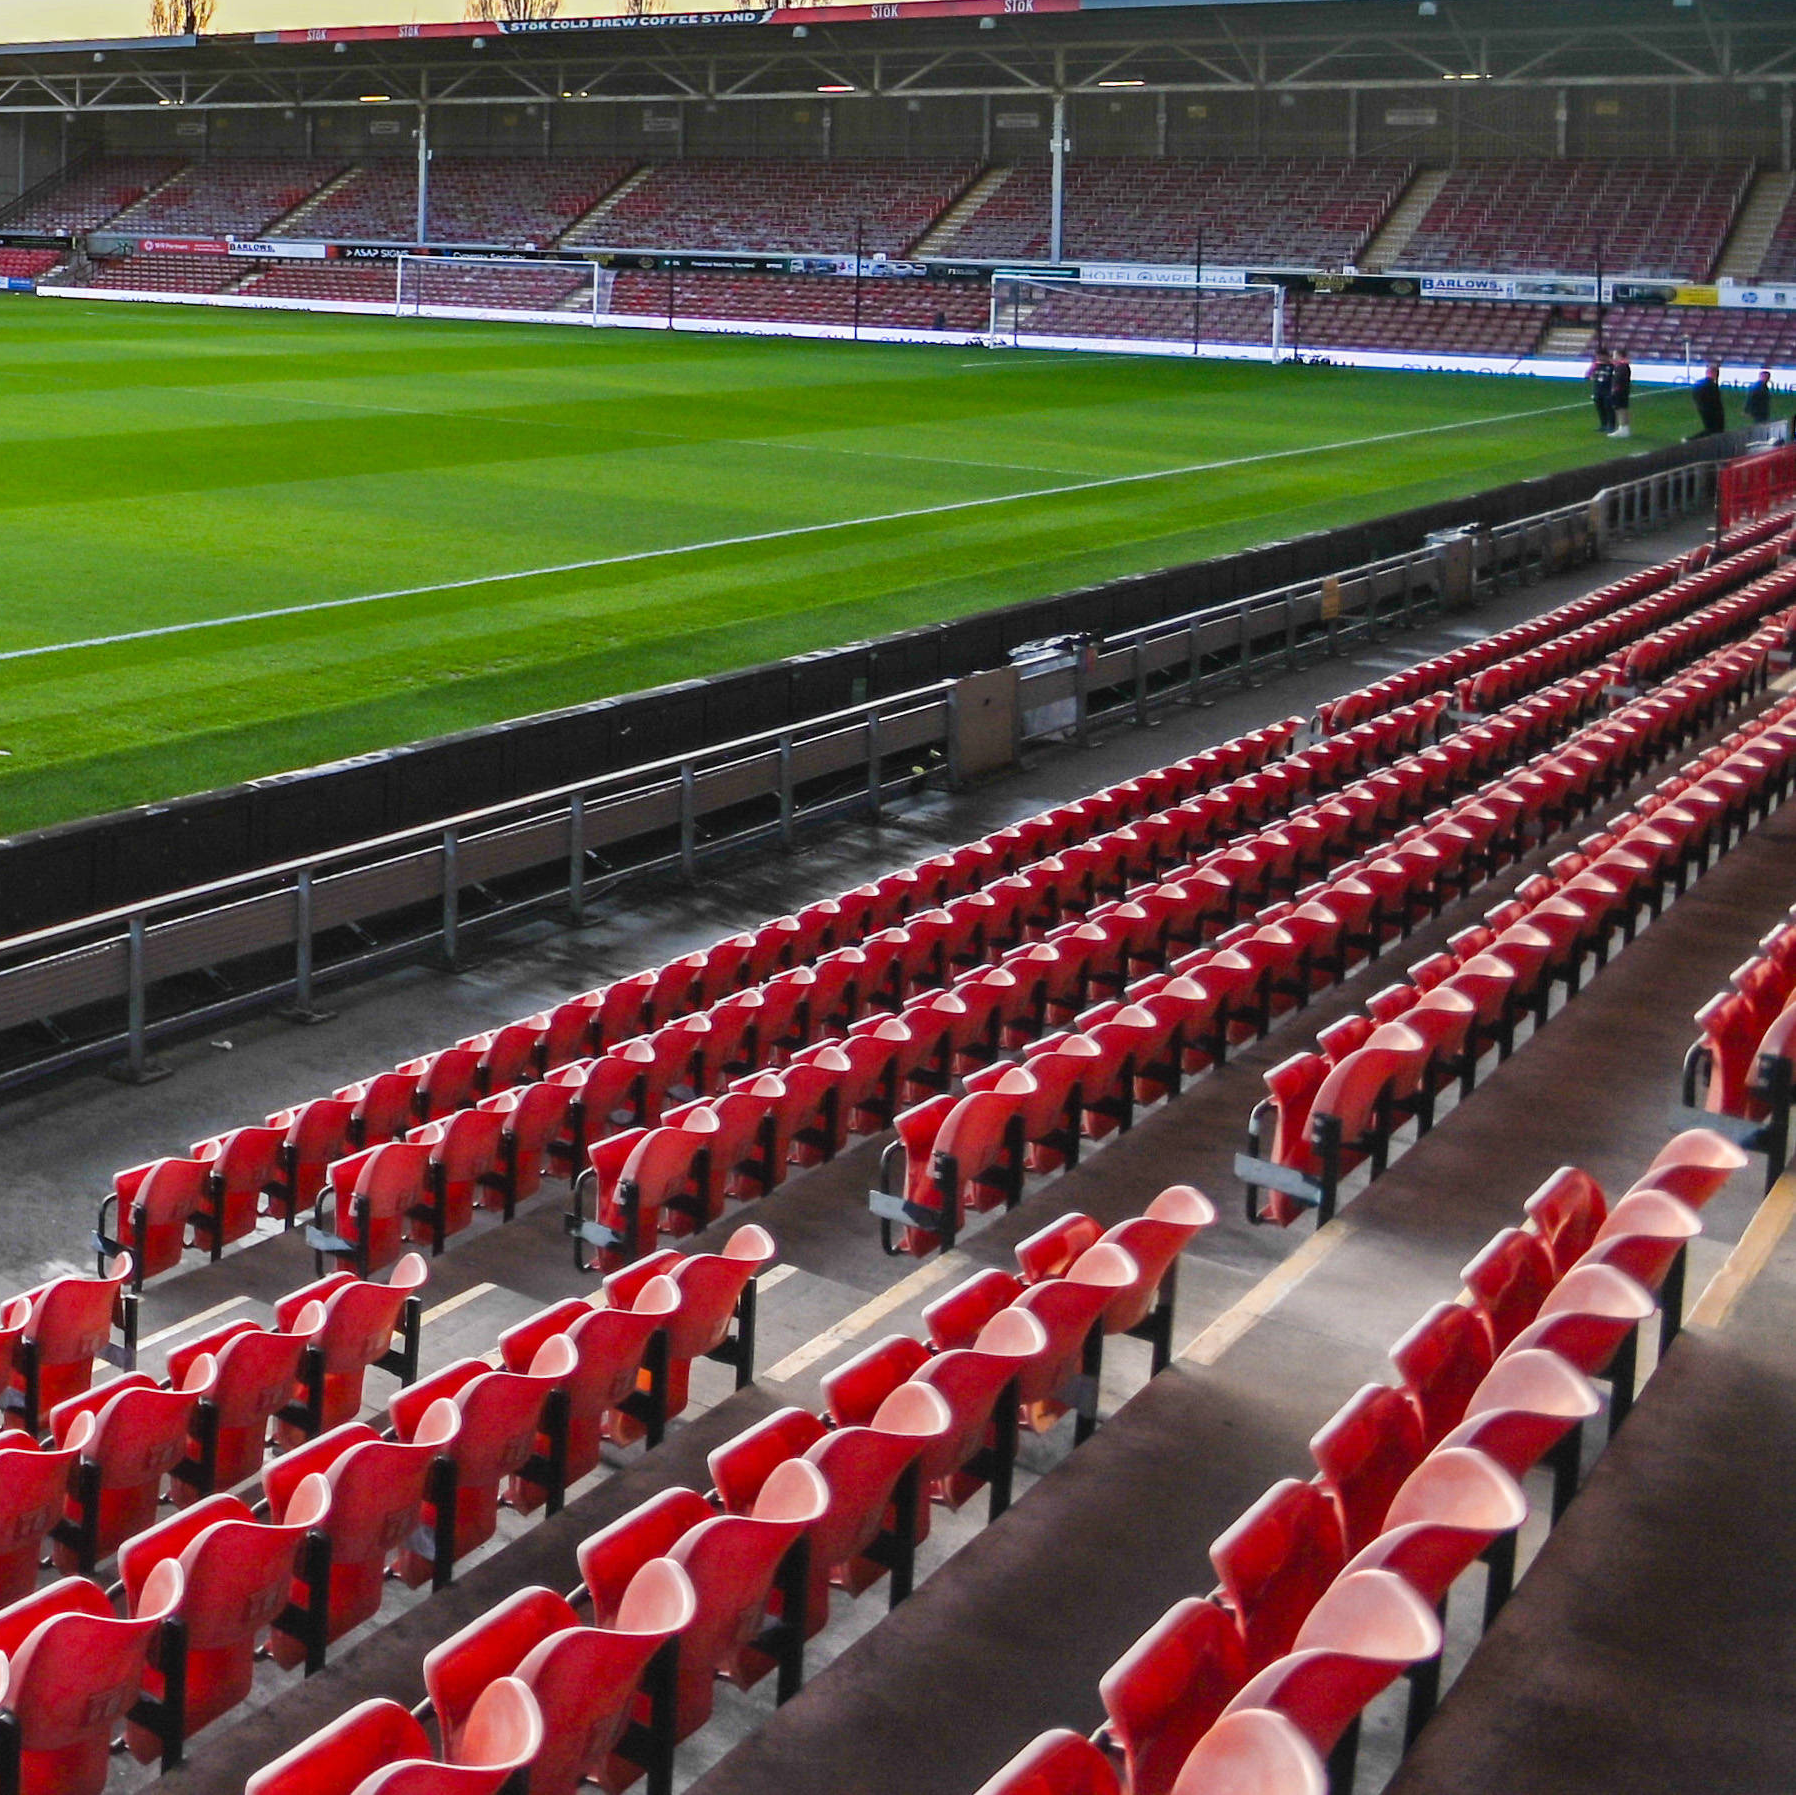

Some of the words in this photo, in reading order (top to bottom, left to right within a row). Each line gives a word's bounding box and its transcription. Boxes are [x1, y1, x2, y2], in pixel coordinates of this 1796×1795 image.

[551, 19, 589, 30] COLD
[592, 17, 638, 28] BREW
[639, 14, 699, 26] COFFEE
[701, 12, 756, 24] STAND
